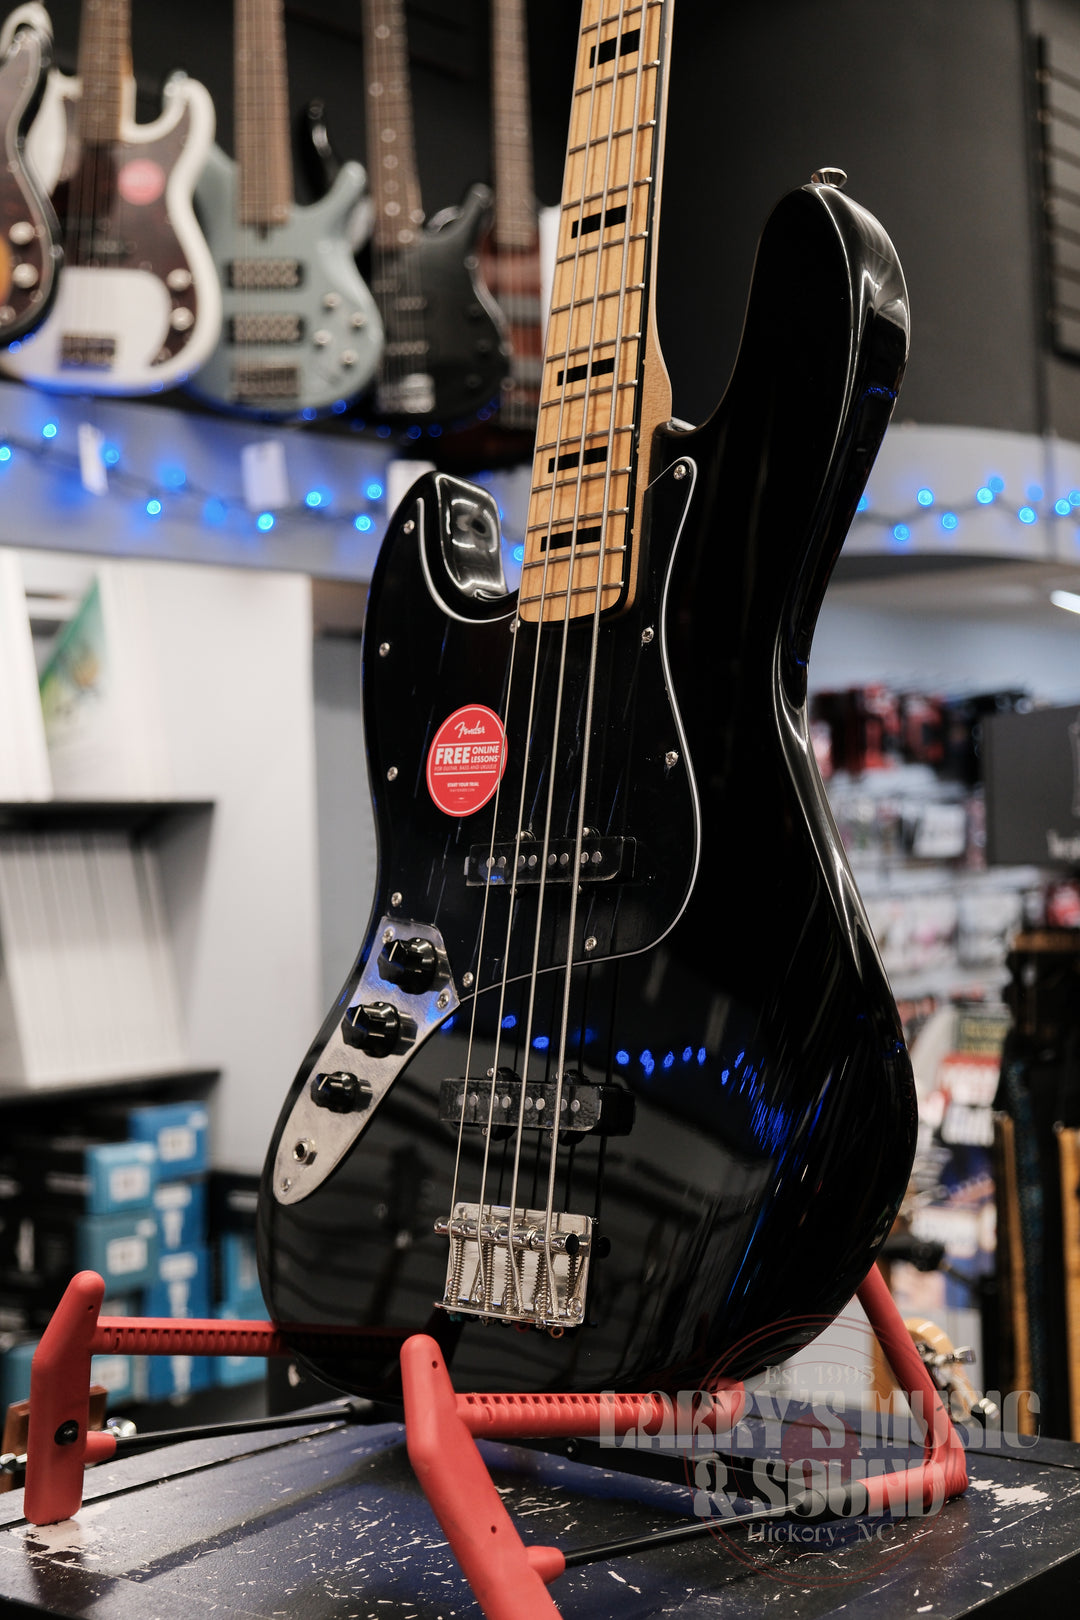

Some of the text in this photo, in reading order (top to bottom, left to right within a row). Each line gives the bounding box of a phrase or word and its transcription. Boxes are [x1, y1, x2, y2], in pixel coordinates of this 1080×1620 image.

[454, 720, 485, 738] Fender
[435, 745, 499, 765] FREE ONLINE
